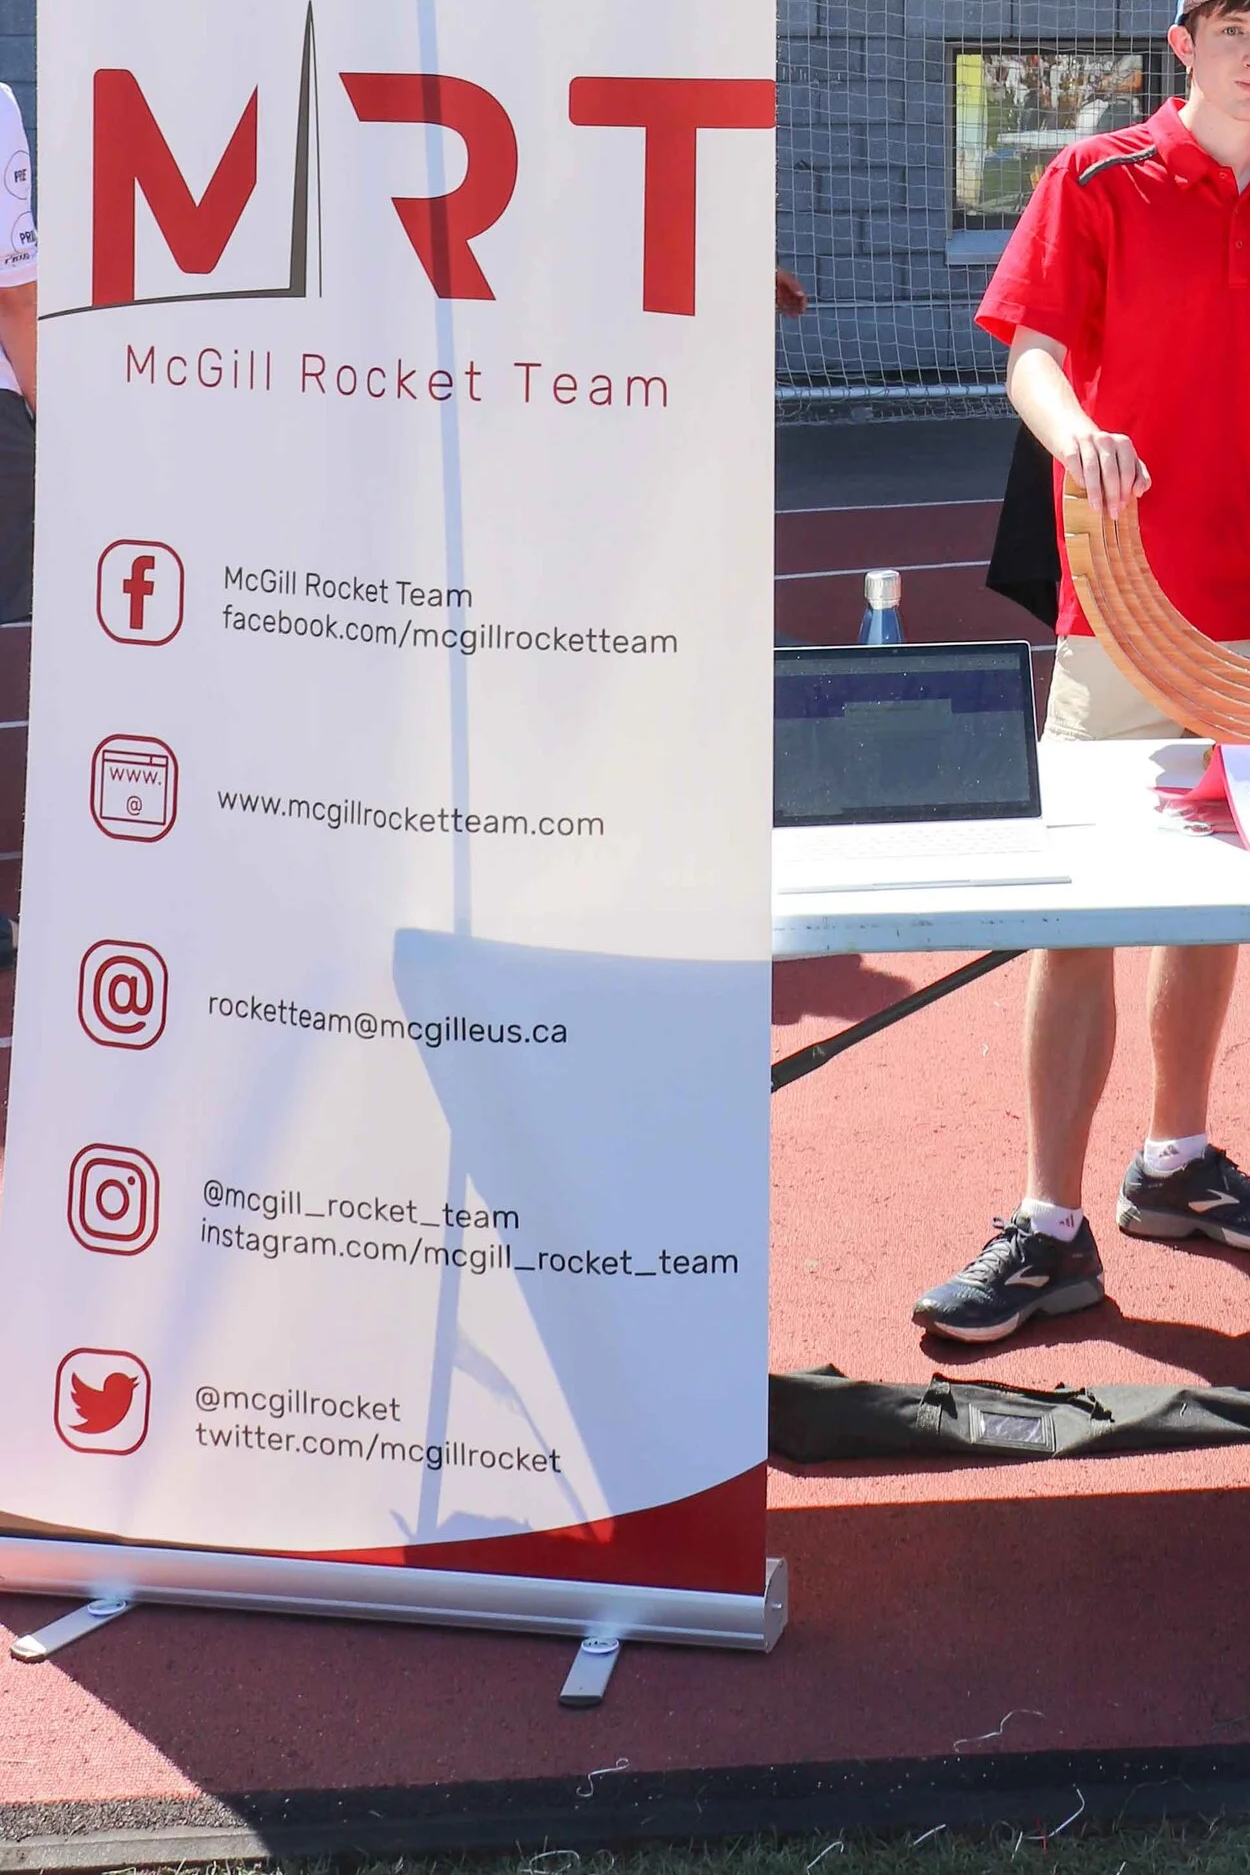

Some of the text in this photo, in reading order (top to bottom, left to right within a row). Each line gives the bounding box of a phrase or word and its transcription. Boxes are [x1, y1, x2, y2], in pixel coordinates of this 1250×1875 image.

[92, 67, 776, 317] MRT
[125, 343, 669, 409] McGill Rocket Team
[223, 565, 473, 609] McGill Rocket Team
[221, 604, 679, 656] facebook.com/mcgillrocketteam
[217, 788, 605, 838] www.mcgillrocketteam.com
[208, 993, 568, 1049] rocketteam@mcgilleus.ca
[202, 1178, 521, 1231] @mcgill_rocket_team
[200, 1217, 740, 1276] instagram.com/mcgill_rocket_team
[195, 1384, 402, 1425] @mcgillrocket
[195, 1422, 562, 1474] twitter.com/mcgillrocket
